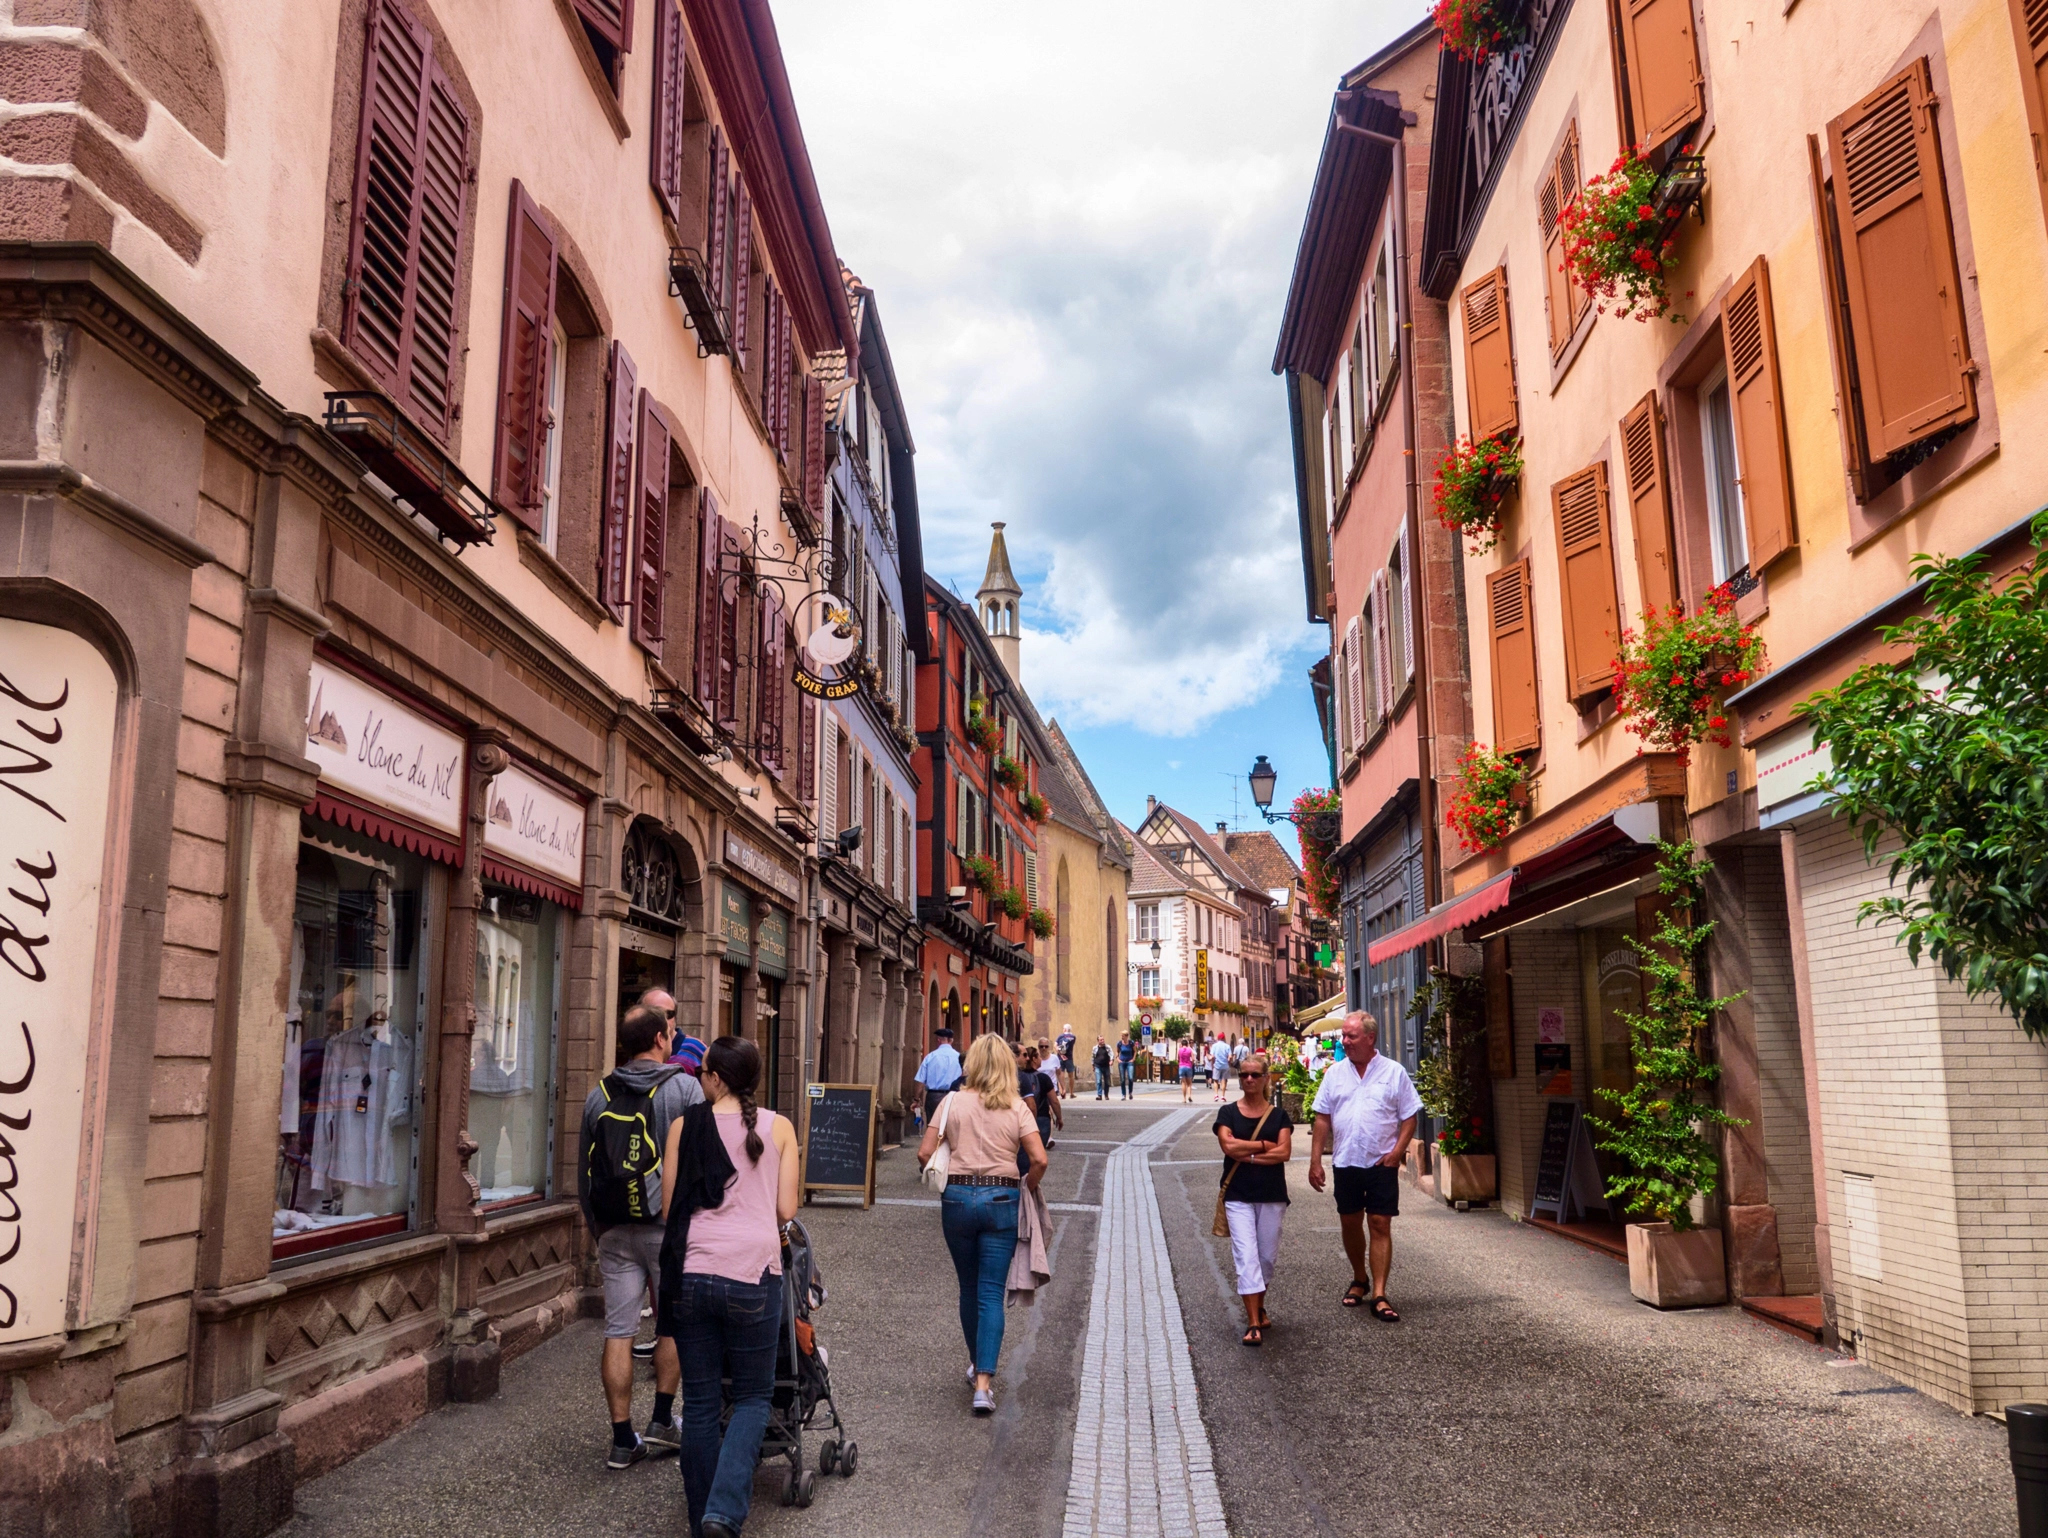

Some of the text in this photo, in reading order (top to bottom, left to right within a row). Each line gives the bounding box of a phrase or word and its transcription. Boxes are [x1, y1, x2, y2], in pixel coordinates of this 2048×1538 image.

[795, 671, 859, 698] FOIE GRAS
[358, 710, 403, 777] Blanc
[408, 744, 427, 789] du
[431, 755, 458, 801] Nil
[518, 793, 581, 859] Blanc du Nil
[1198, 952, 1206, 1001] KODAKS
